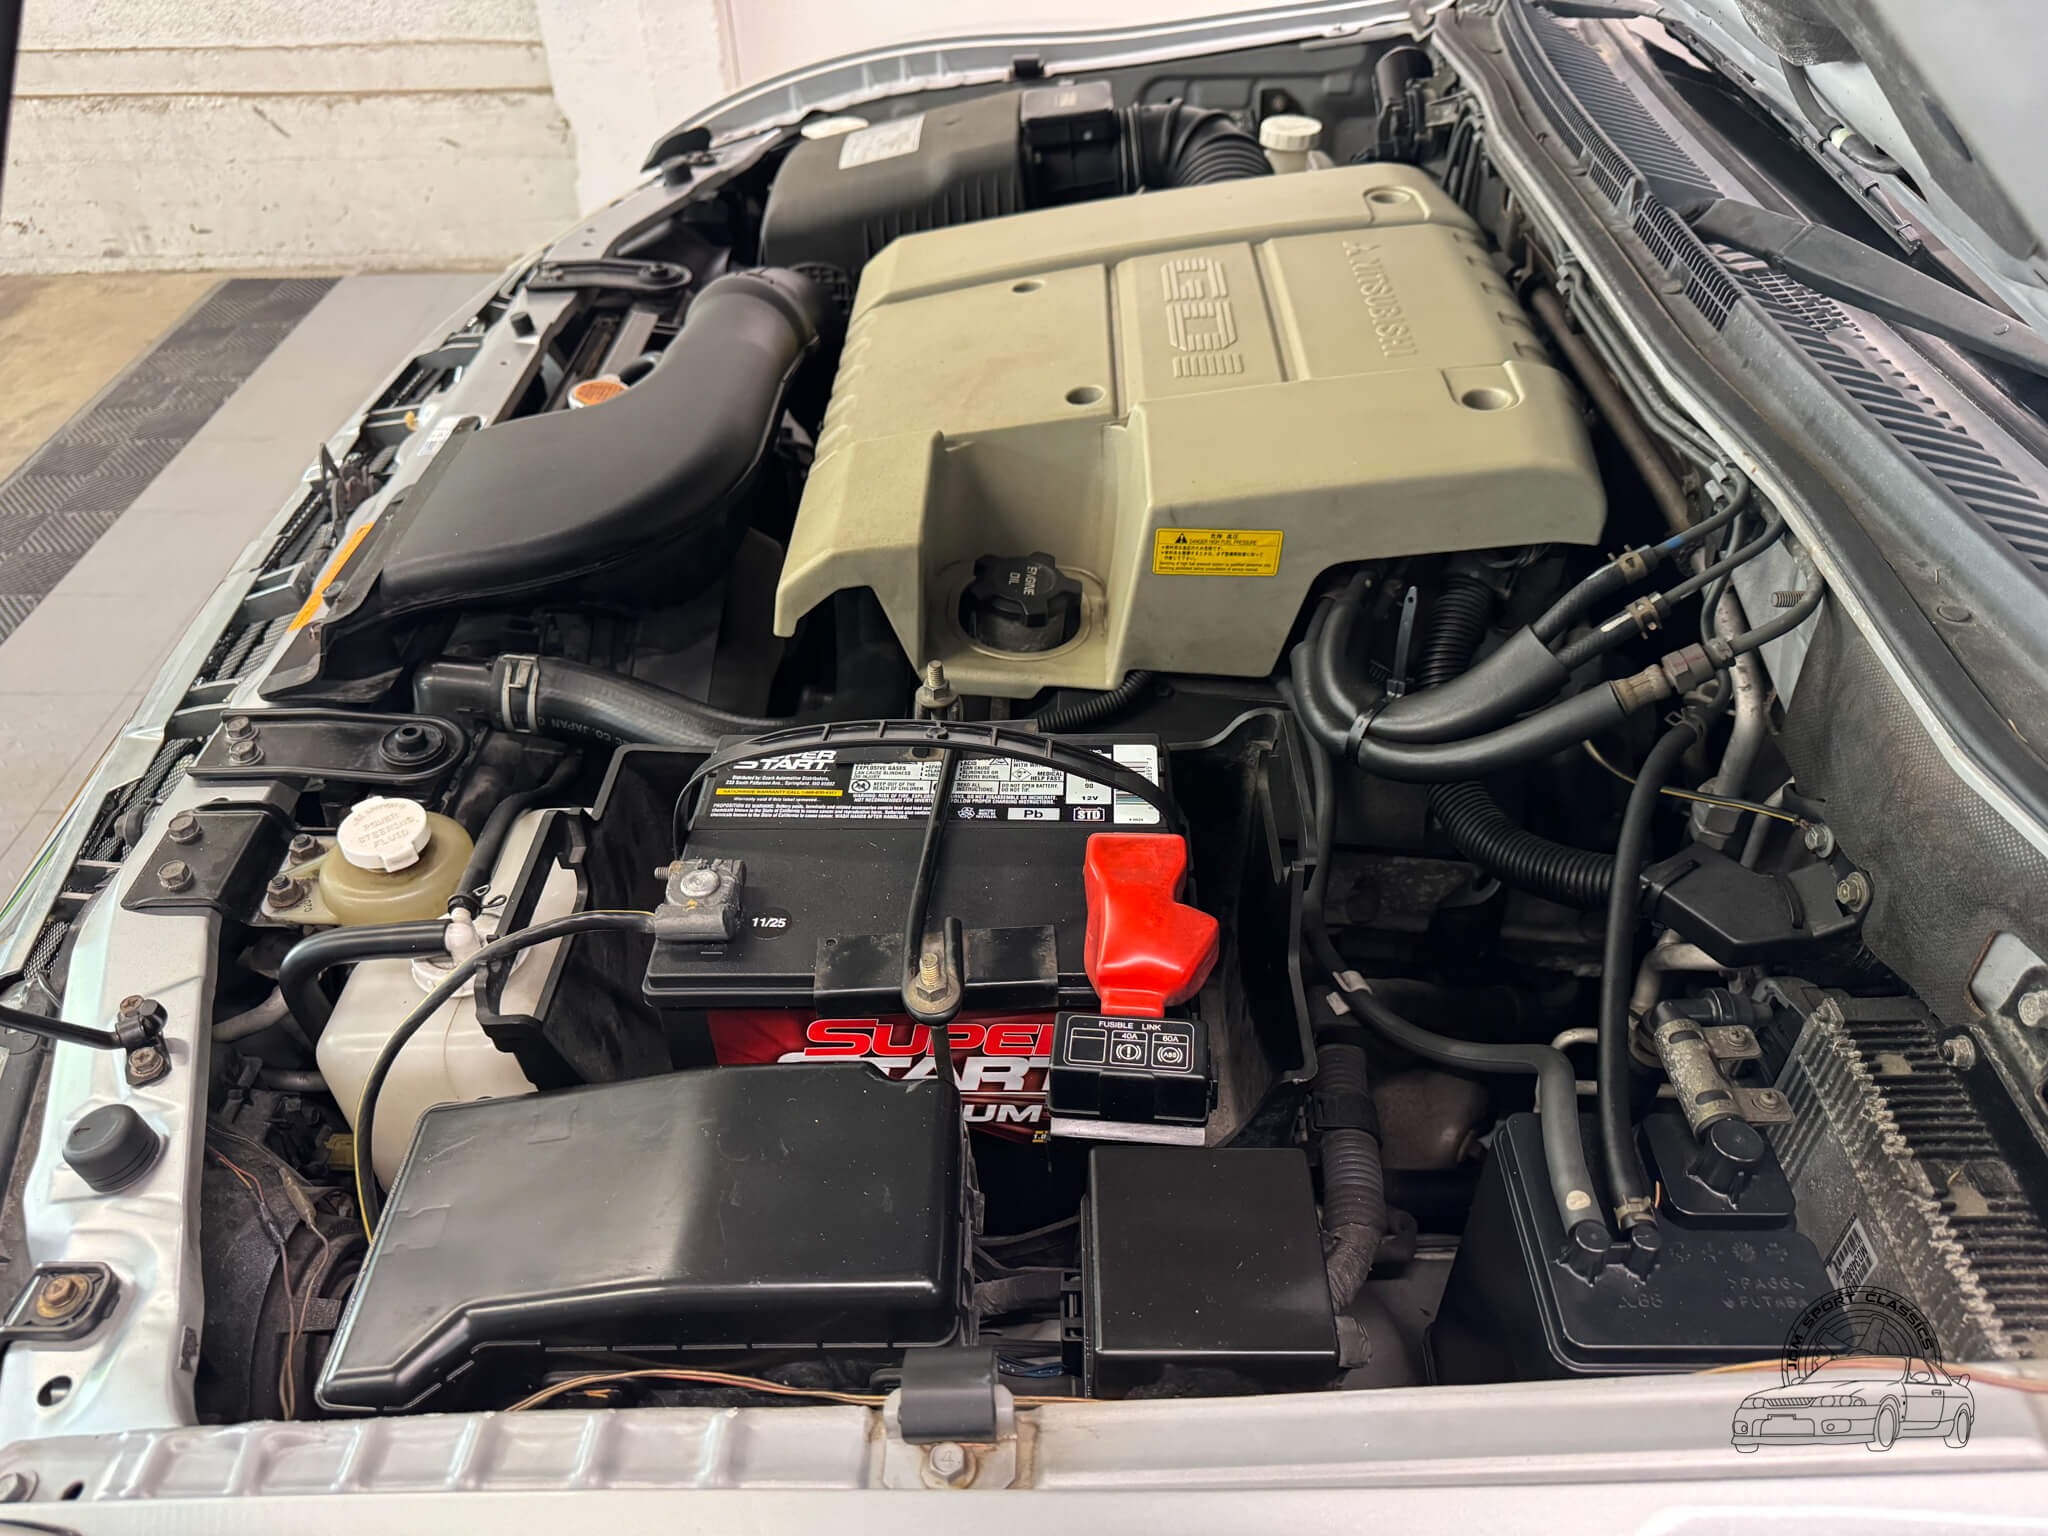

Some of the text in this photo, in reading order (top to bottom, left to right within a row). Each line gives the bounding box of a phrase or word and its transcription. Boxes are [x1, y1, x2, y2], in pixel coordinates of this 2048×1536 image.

[1349, 257, 1418, 358] MITSUBISHI
[1023, 566, 1039, 596] ENGINE
[1024, 809, 1043, 818] Pb
[751, 917, 787, 928] 11/25
[1099, 1020, 1162, 1032] FUSIBLE LINK
